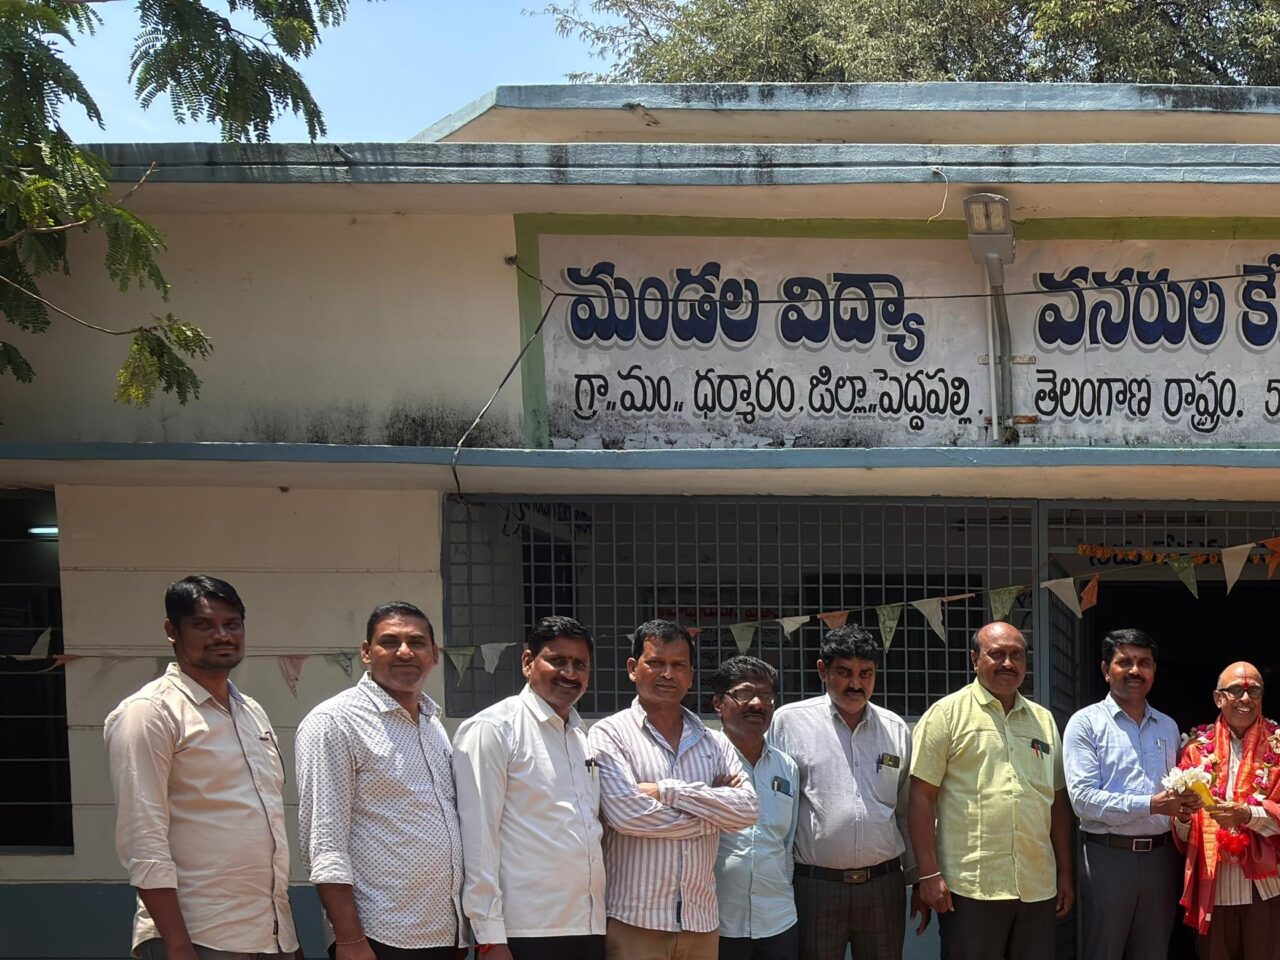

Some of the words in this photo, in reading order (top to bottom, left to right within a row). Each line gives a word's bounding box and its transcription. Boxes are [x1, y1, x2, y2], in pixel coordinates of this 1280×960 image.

[566, 261, 759, 345] మండల
[1037, 265, 1227, 346] వనరుల
[1034, 368, 1152, 418] తెలంగాణ
